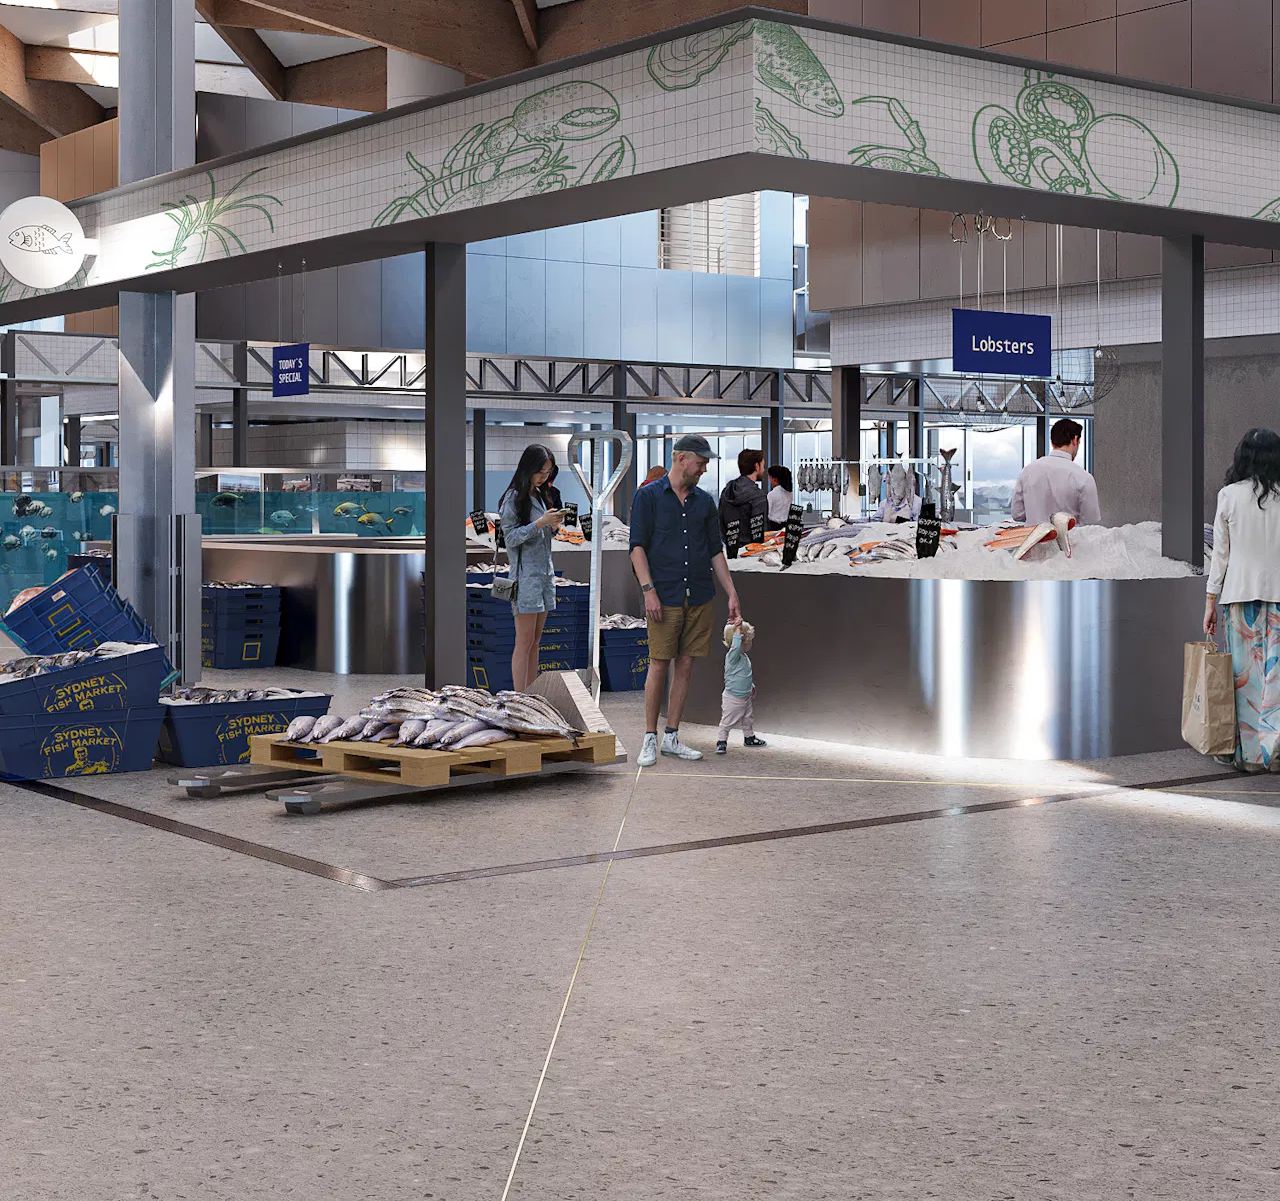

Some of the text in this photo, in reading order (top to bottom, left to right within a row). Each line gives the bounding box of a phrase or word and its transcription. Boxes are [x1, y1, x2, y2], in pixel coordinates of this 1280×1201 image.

[972, 335, 1034, 354] Lobsters
[278, 372, 302, 383] SPECIAL
[55, 676, 105, 699] SYDNEY
[46, 685, 122, 713] FISH MARKET
[228, 714, 275, 729] SYDNEY
[54, 727, 102, 742] SYDNEY
[217, 724, 288, 743] FISH MARKET
[43, 738, 117, 756] FISH MARKET
